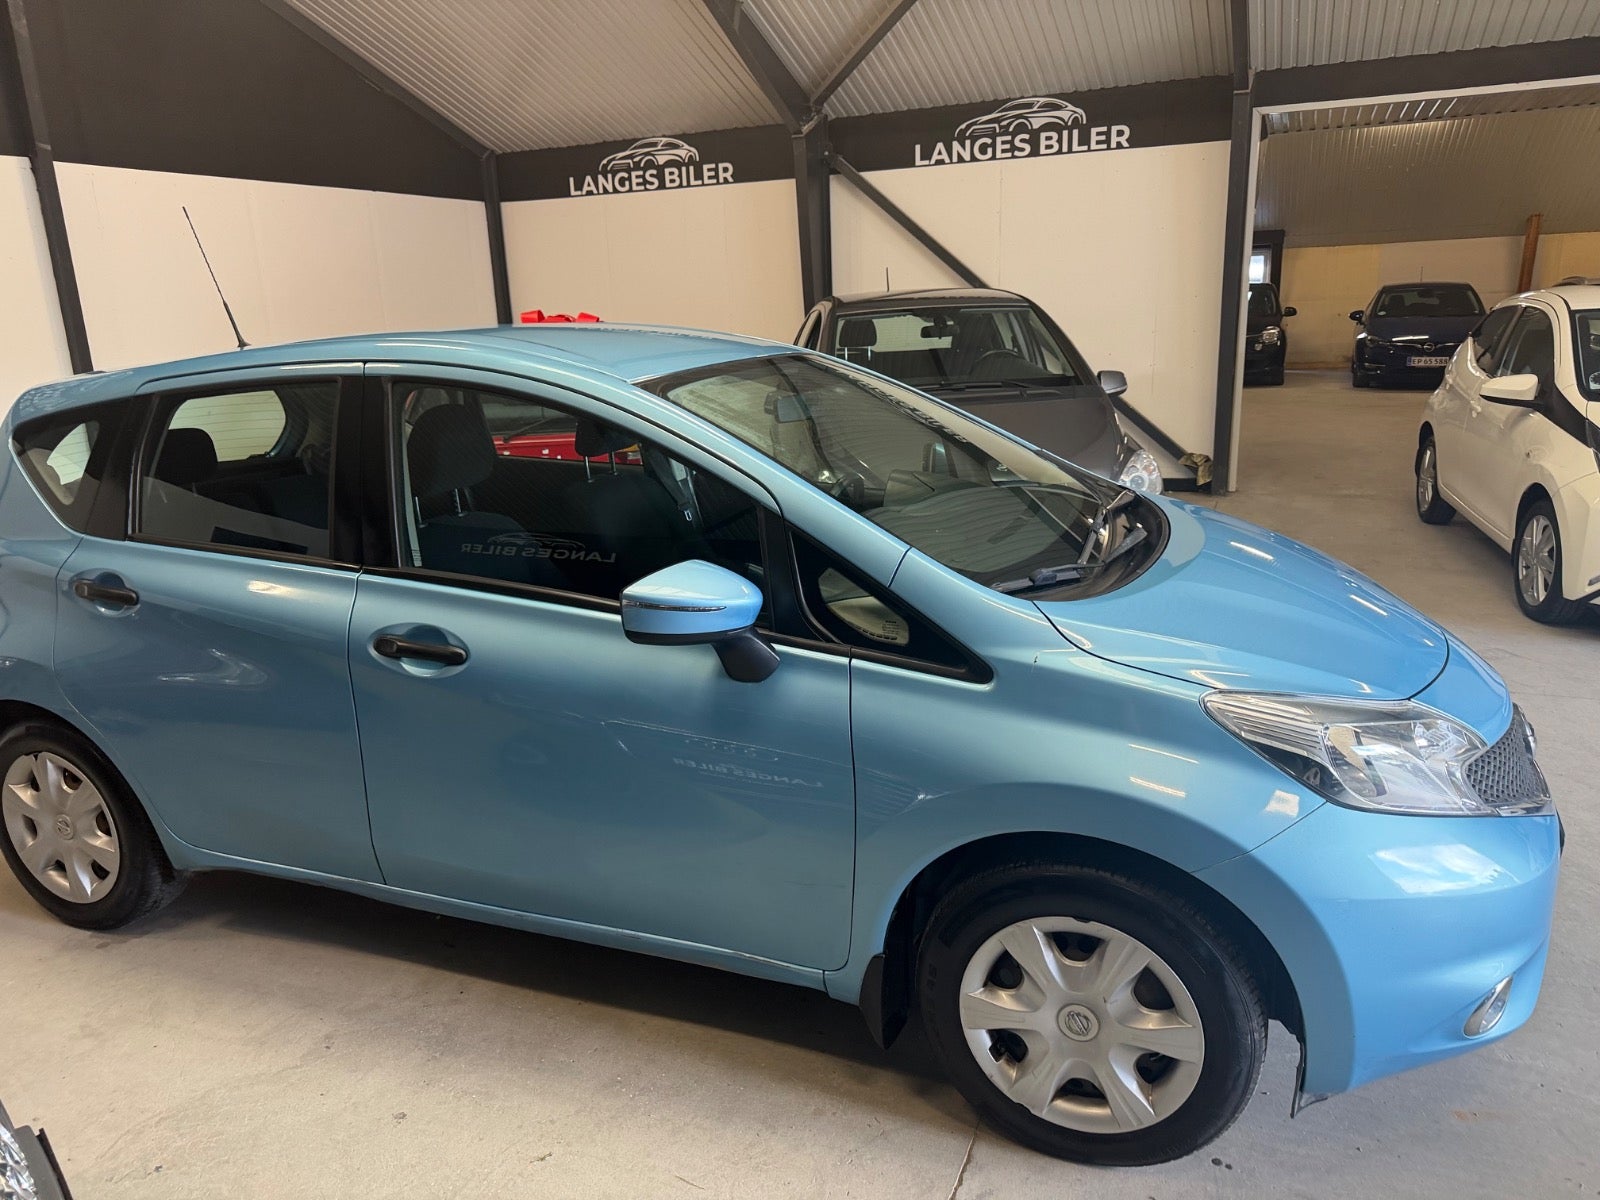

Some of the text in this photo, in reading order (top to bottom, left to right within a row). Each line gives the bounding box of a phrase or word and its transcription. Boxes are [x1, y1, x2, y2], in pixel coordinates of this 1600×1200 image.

[914, 124, 1131, 166] LANGES BILER
[568, 162, 734, 196] LANGES BILER
